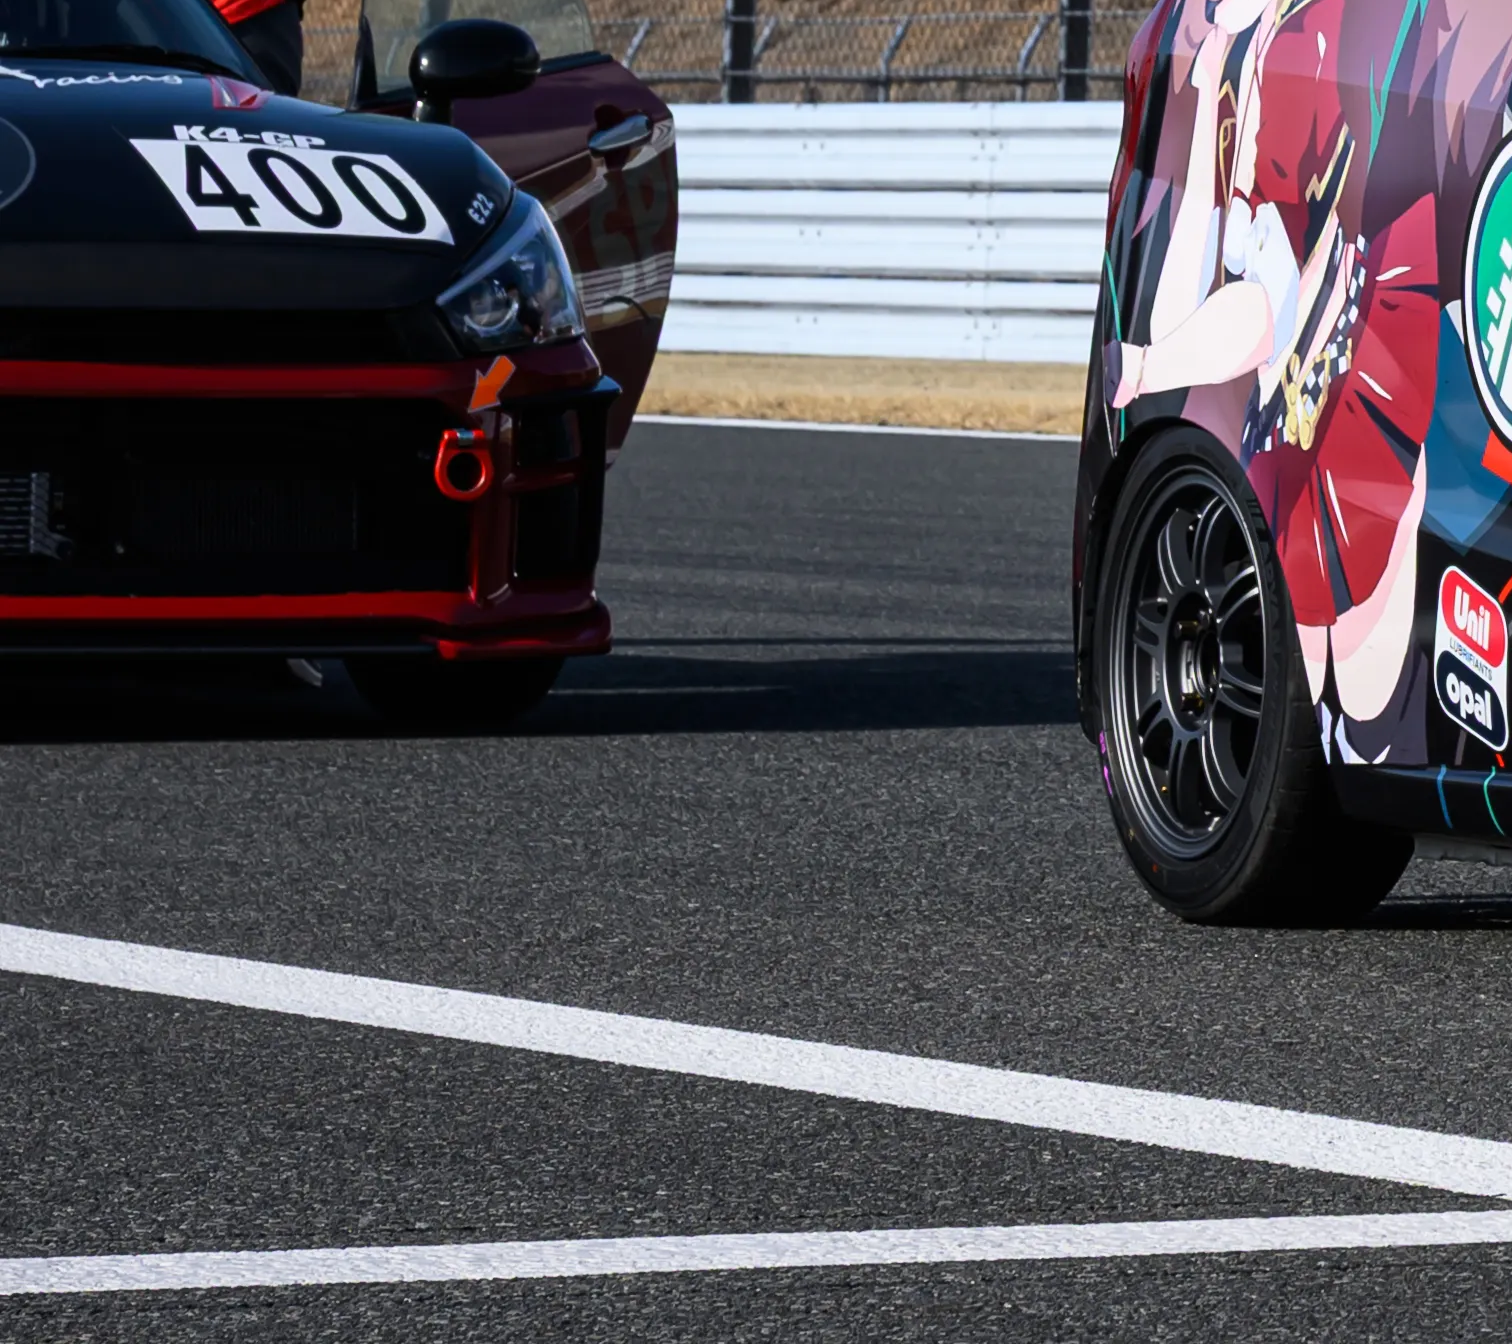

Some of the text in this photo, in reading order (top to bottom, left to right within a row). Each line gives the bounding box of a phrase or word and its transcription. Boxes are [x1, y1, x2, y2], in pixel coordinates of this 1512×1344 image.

[173, 125, 326, 148] K4-GP
[184, 144, 427, 235] 400
[1453, 585, 1491, 652] Unil
[1449, 637, 1493, 682] LUBRIFIANTS
[1445, 672, 1493, 731] opal
